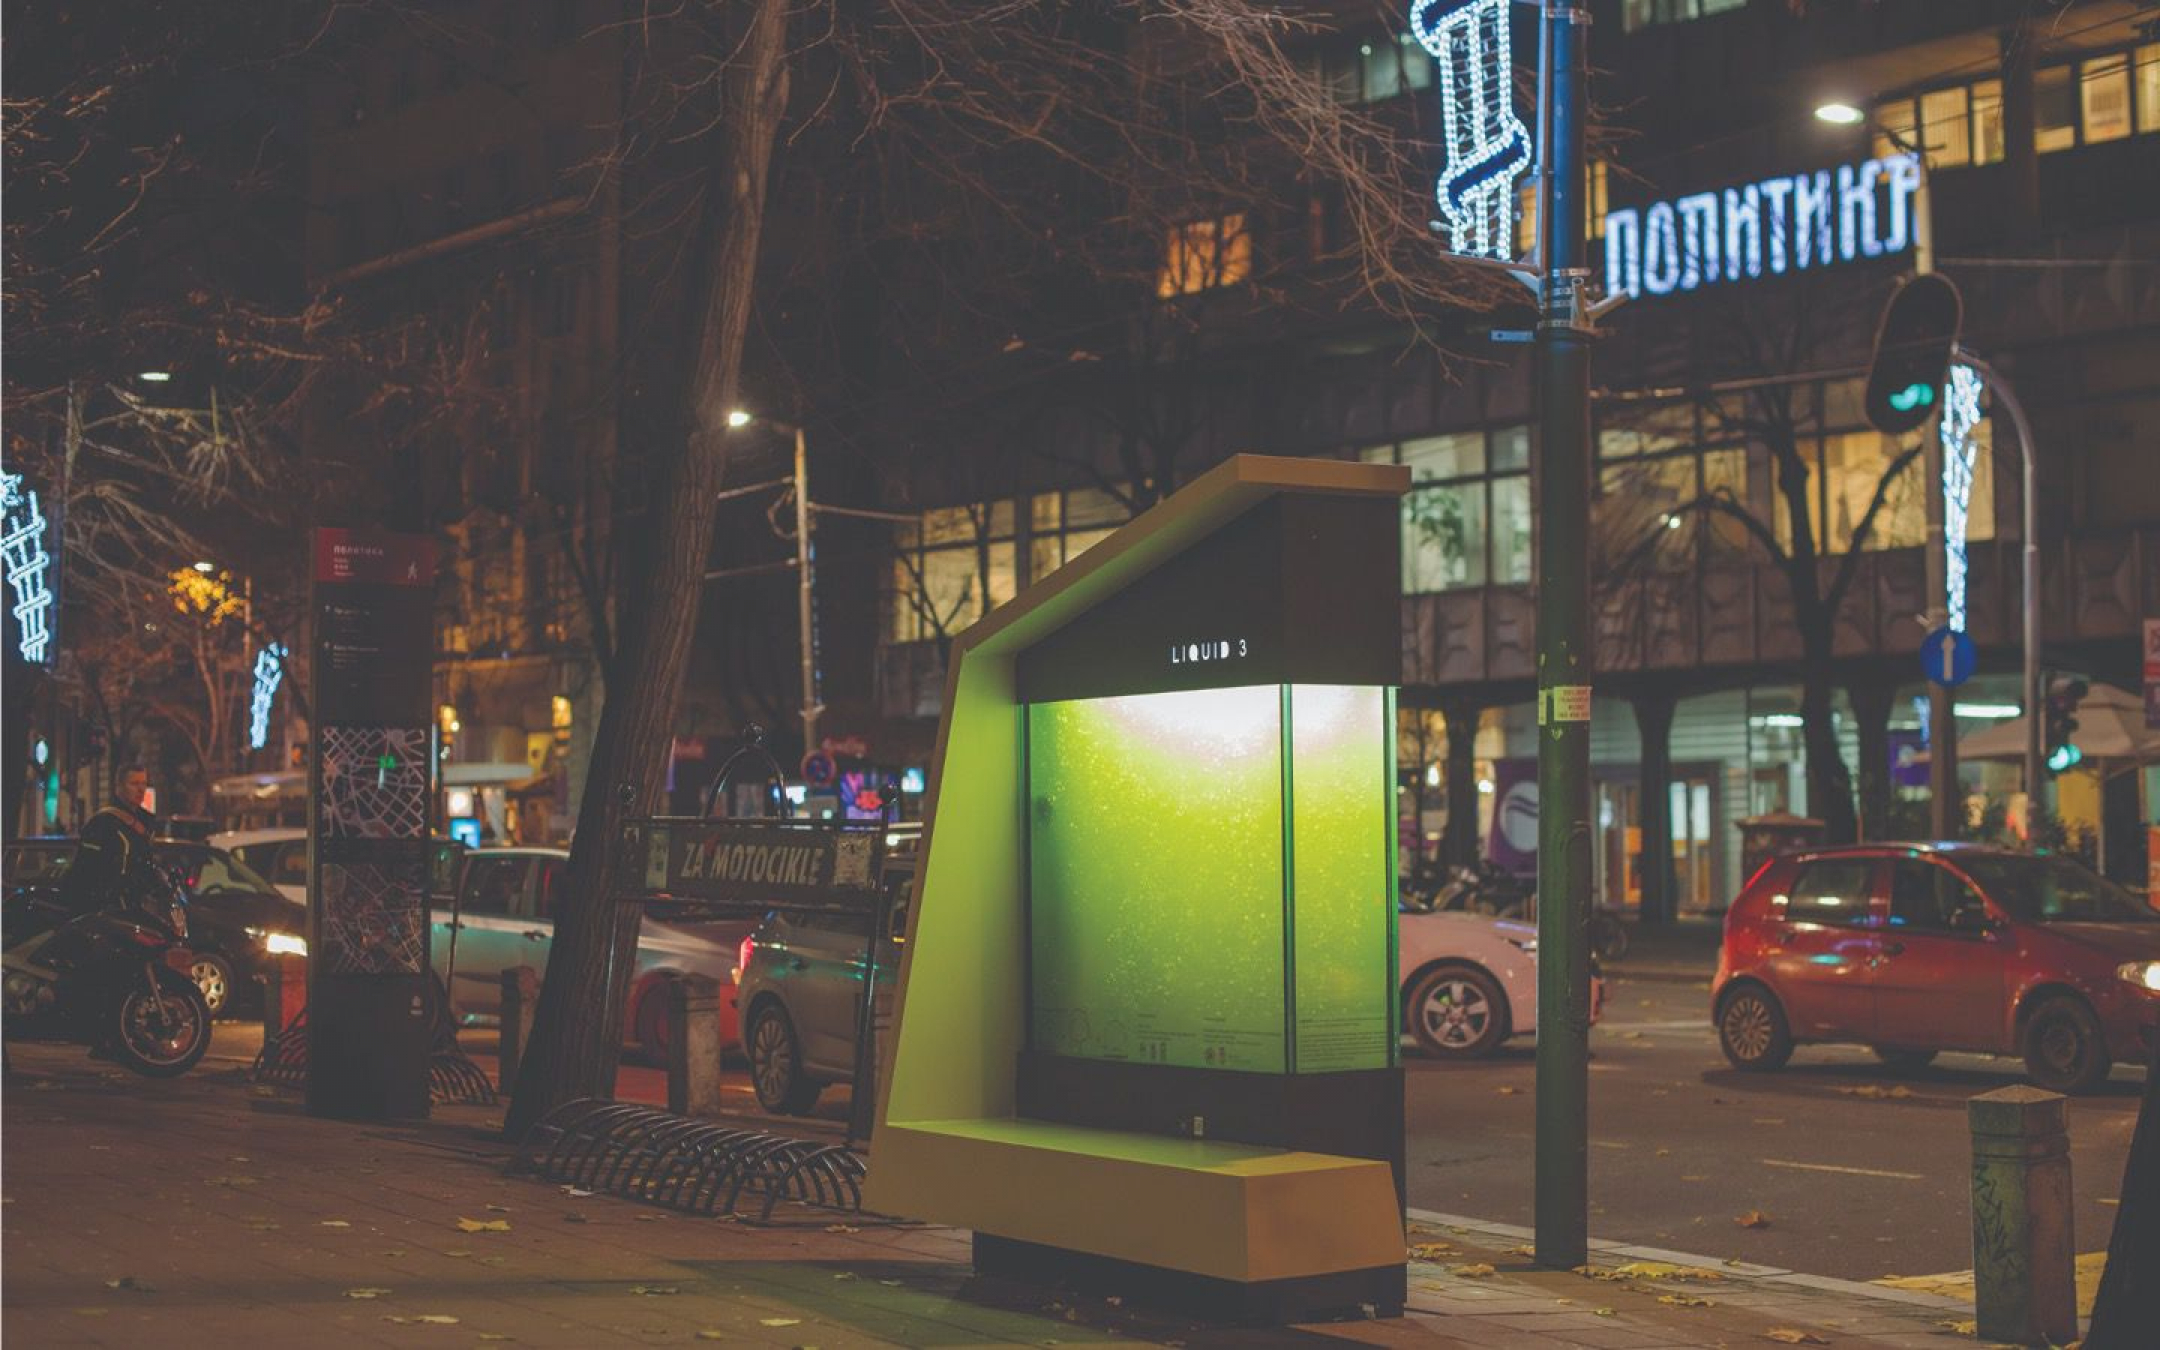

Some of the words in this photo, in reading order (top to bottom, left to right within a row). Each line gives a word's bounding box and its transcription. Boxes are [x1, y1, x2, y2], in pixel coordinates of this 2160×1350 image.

[1172, 641, 1230, 664] LIQUID
[1239, 638, 1247, 657] 3
[681, 843, 705, 877] ZA
[710, 844, 824, 885] MOTOCIKLE
